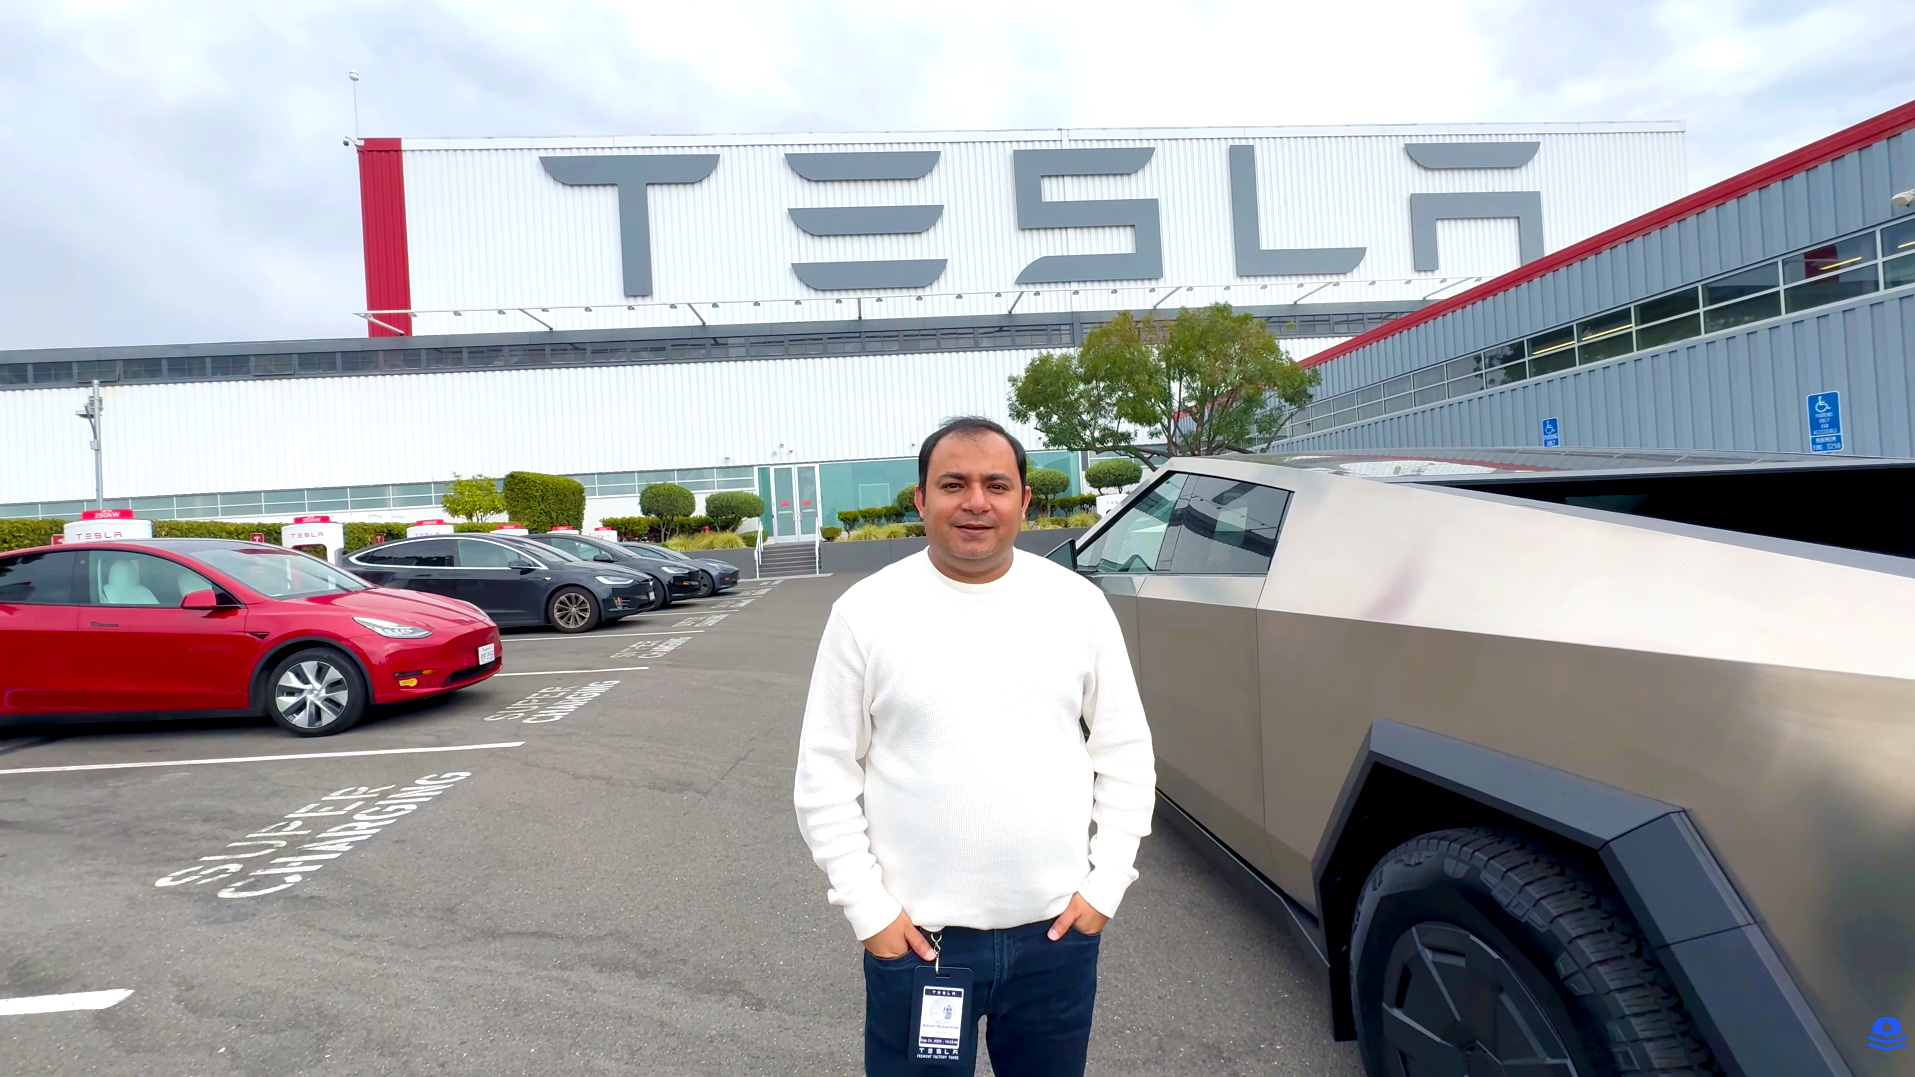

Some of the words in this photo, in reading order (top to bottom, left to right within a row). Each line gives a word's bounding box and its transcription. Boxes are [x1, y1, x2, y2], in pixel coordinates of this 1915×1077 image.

[538, 139, 1545, 297] TESLA
[75, 531, 123, 540] TESLA
[290, 531, 325, 539] TESLA
[484, 686, 578, 722] SUPER
[522, 680, 621, 724] CHARGING
[155, 784, 396, 888] SUPER
[217, 771, 472, 899] CHARGING
